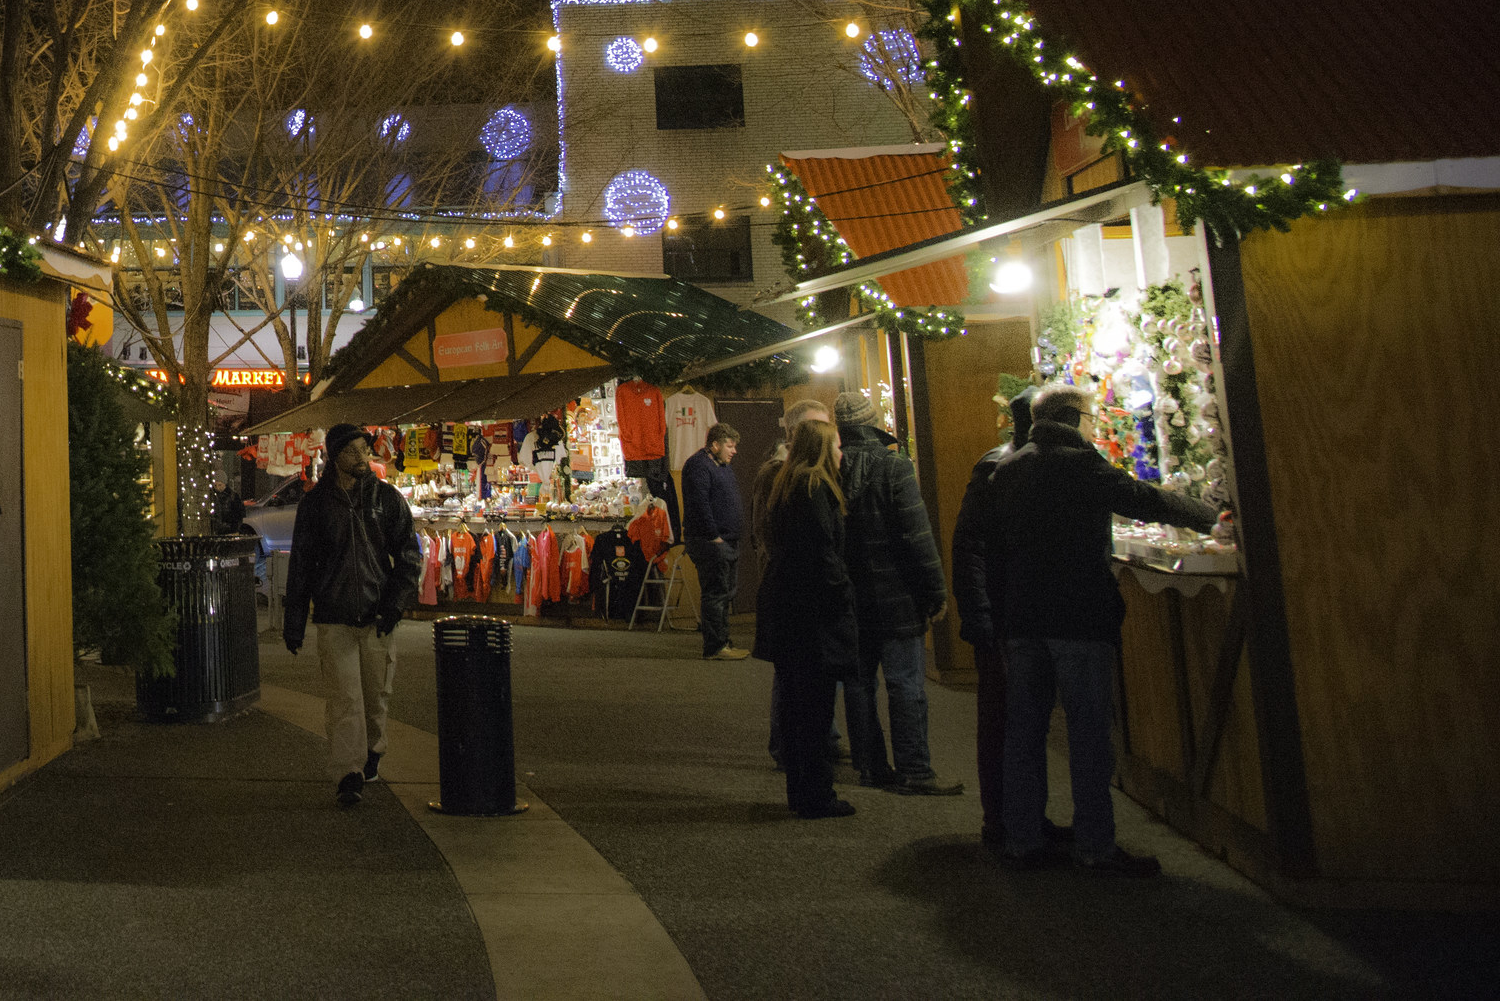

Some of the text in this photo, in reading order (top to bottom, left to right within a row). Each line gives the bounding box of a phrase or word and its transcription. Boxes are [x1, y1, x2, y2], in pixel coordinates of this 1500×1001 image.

[438, 339, 503, 356] European Folk Art
[212, 369, 286, 385] MARKET
